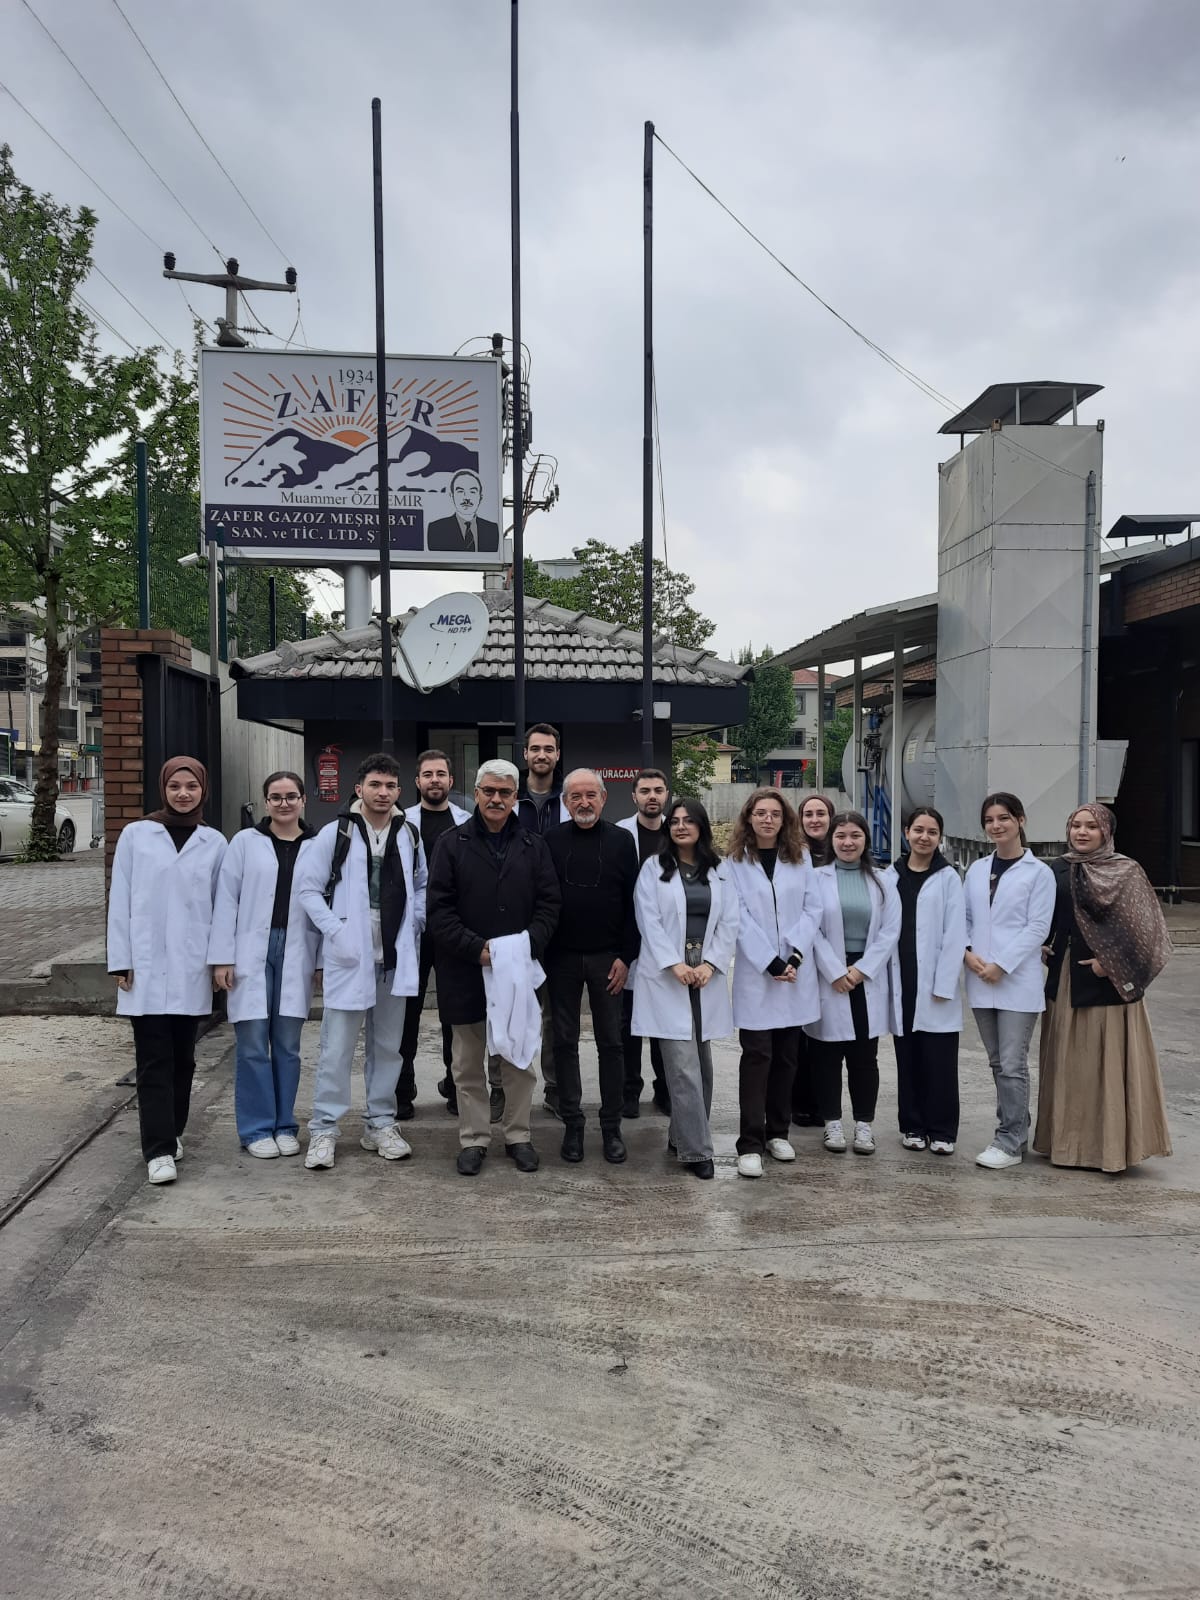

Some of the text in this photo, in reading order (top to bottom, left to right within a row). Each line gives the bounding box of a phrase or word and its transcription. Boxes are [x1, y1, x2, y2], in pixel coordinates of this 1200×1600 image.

[338, 369, 375, 384] 1934
[273, 388, 435, 427] ZAFER
[281, 491, 348, 505] Muammer
[210, 509, 264, 522] ZAFER
[268, 511, 326, 524] GAZOZ
[231, 526, 397, 543] SAN. ve TİC. LTD. Ş.
[437, 614, 472, 626] MEGA
